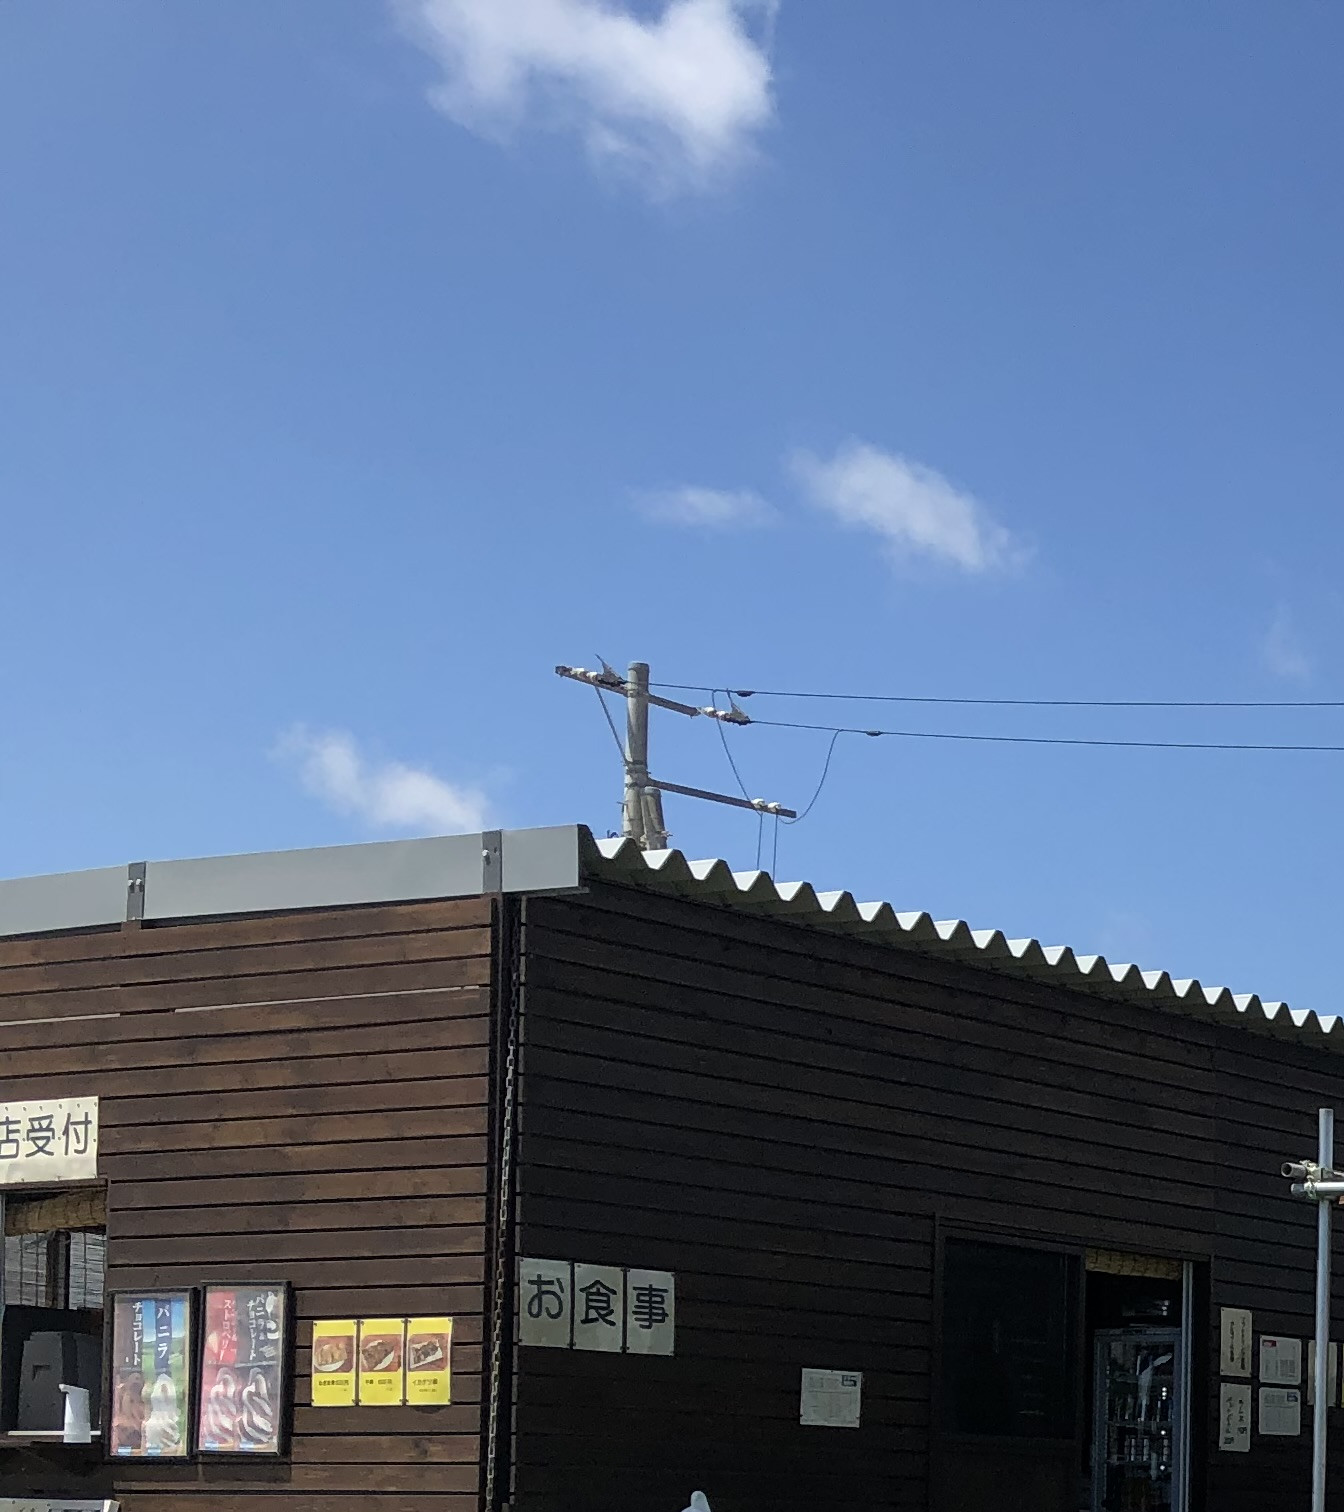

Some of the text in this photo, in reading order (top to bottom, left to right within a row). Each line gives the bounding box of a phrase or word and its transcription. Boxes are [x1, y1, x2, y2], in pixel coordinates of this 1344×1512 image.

[528, 1274, 669, 1330] お食事
[132, 1301, 143, 1366] チョコレート
[157, 1306, 170, 1359] バニラ
